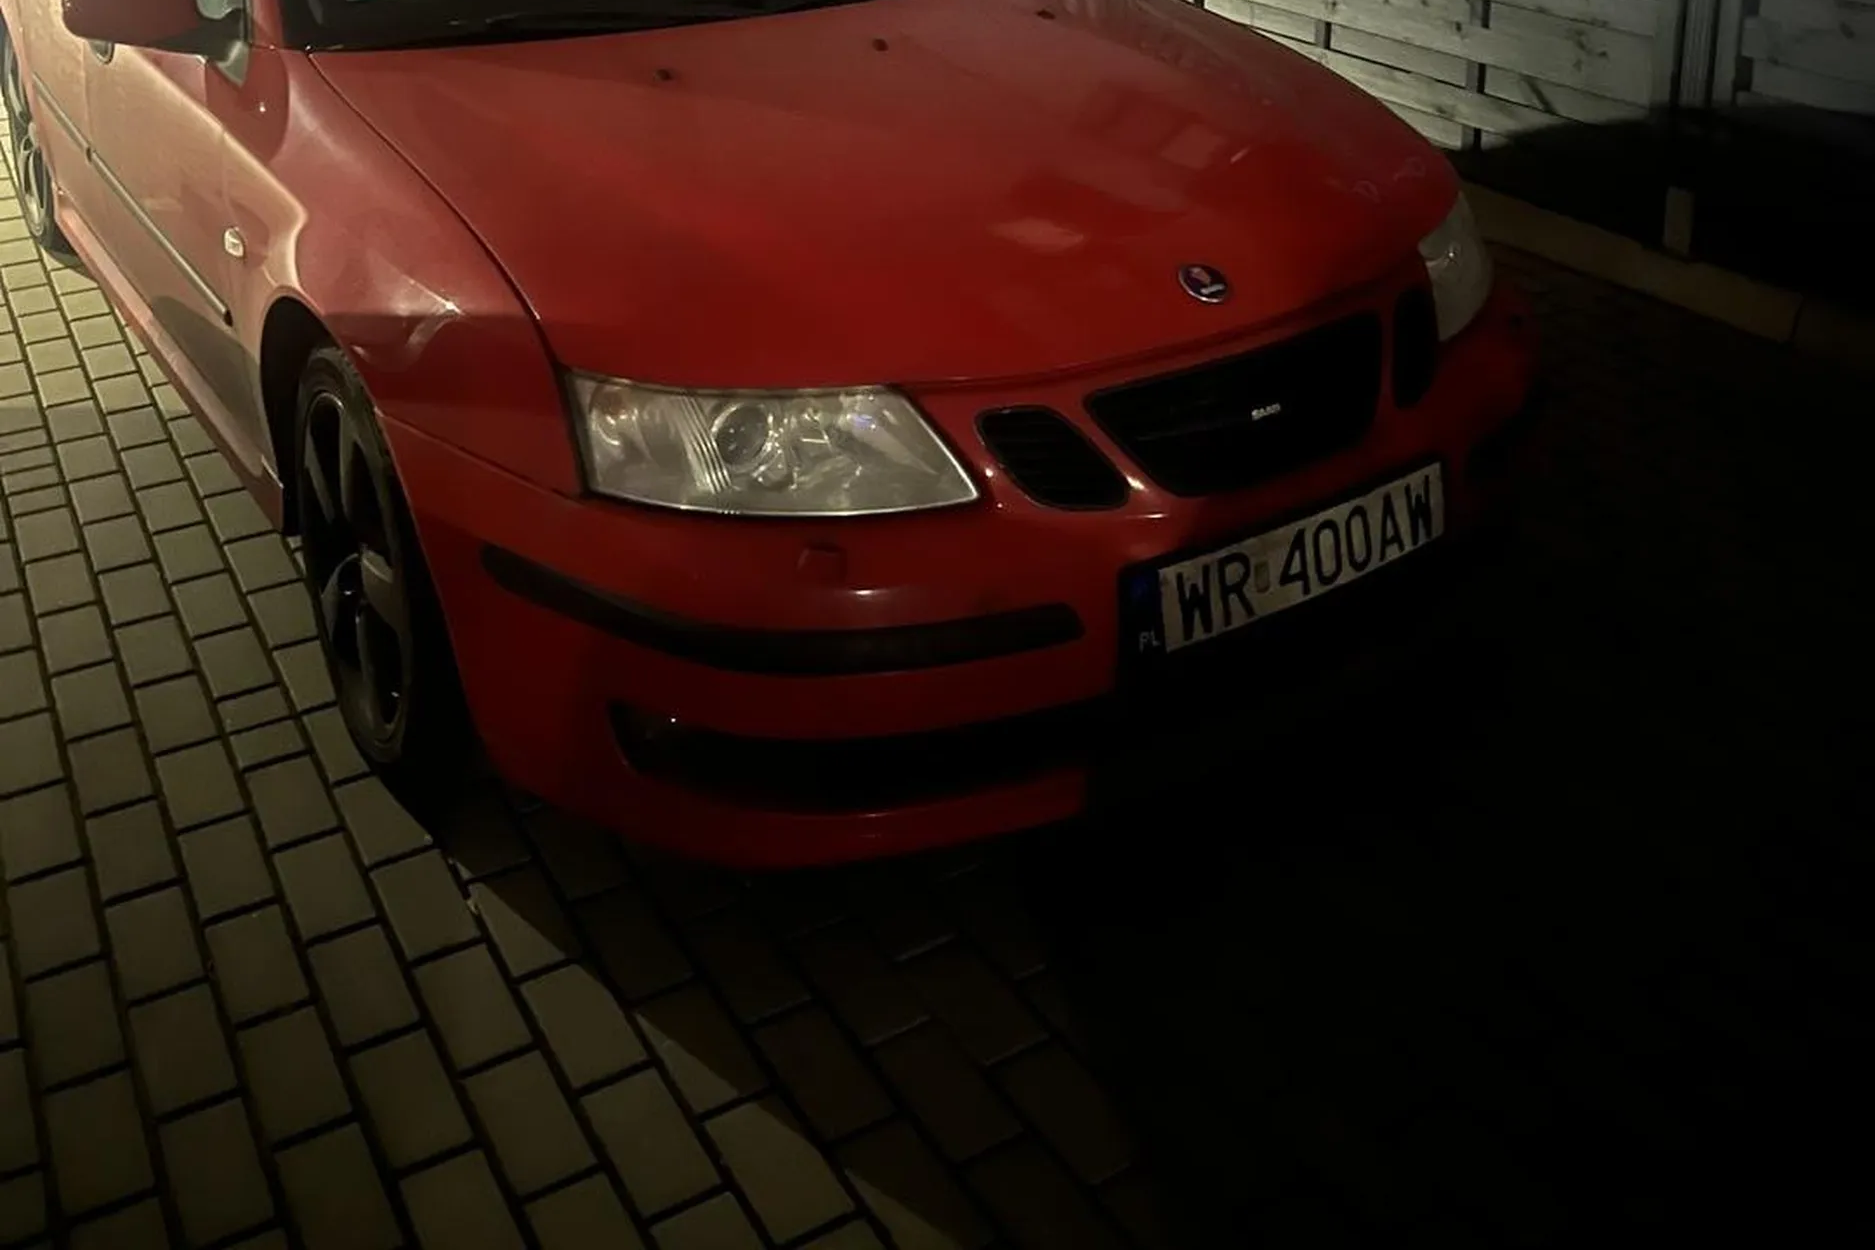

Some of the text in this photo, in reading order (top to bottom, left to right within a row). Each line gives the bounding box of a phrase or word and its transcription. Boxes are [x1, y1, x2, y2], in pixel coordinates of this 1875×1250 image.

[1176, 475, 1433, 641] WR 400AW
[1138, 626, 1160, 654] PL
